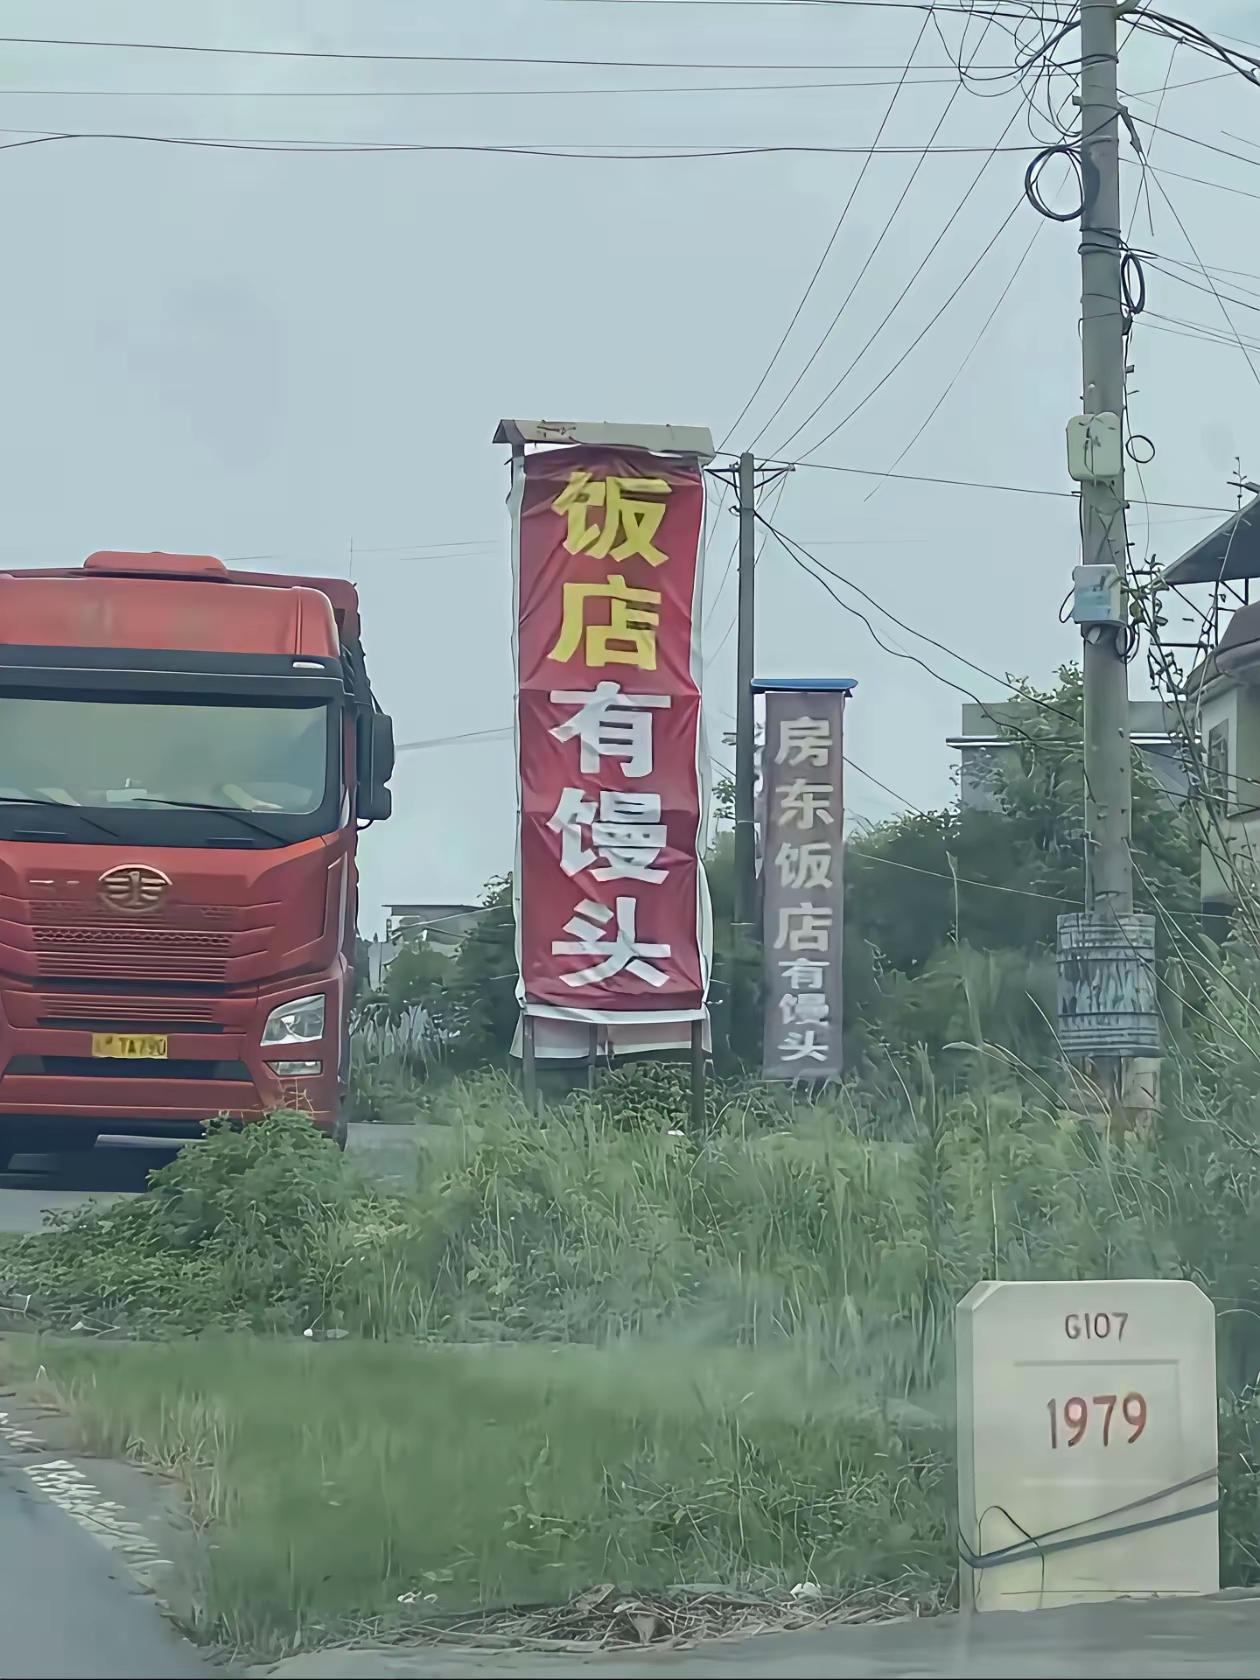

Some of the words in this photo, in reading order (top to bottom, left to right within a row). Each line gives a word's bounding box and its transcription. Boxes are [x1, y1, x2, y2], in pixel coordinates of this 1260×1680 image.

[549, 470, 672, 988] 饭店有馒头
[774, 716, 834, 1062] 房东饭店有馒头
[1047, 1391, 1147, 1449] 1979
[1065, 1312, 1129, 1341] G107
